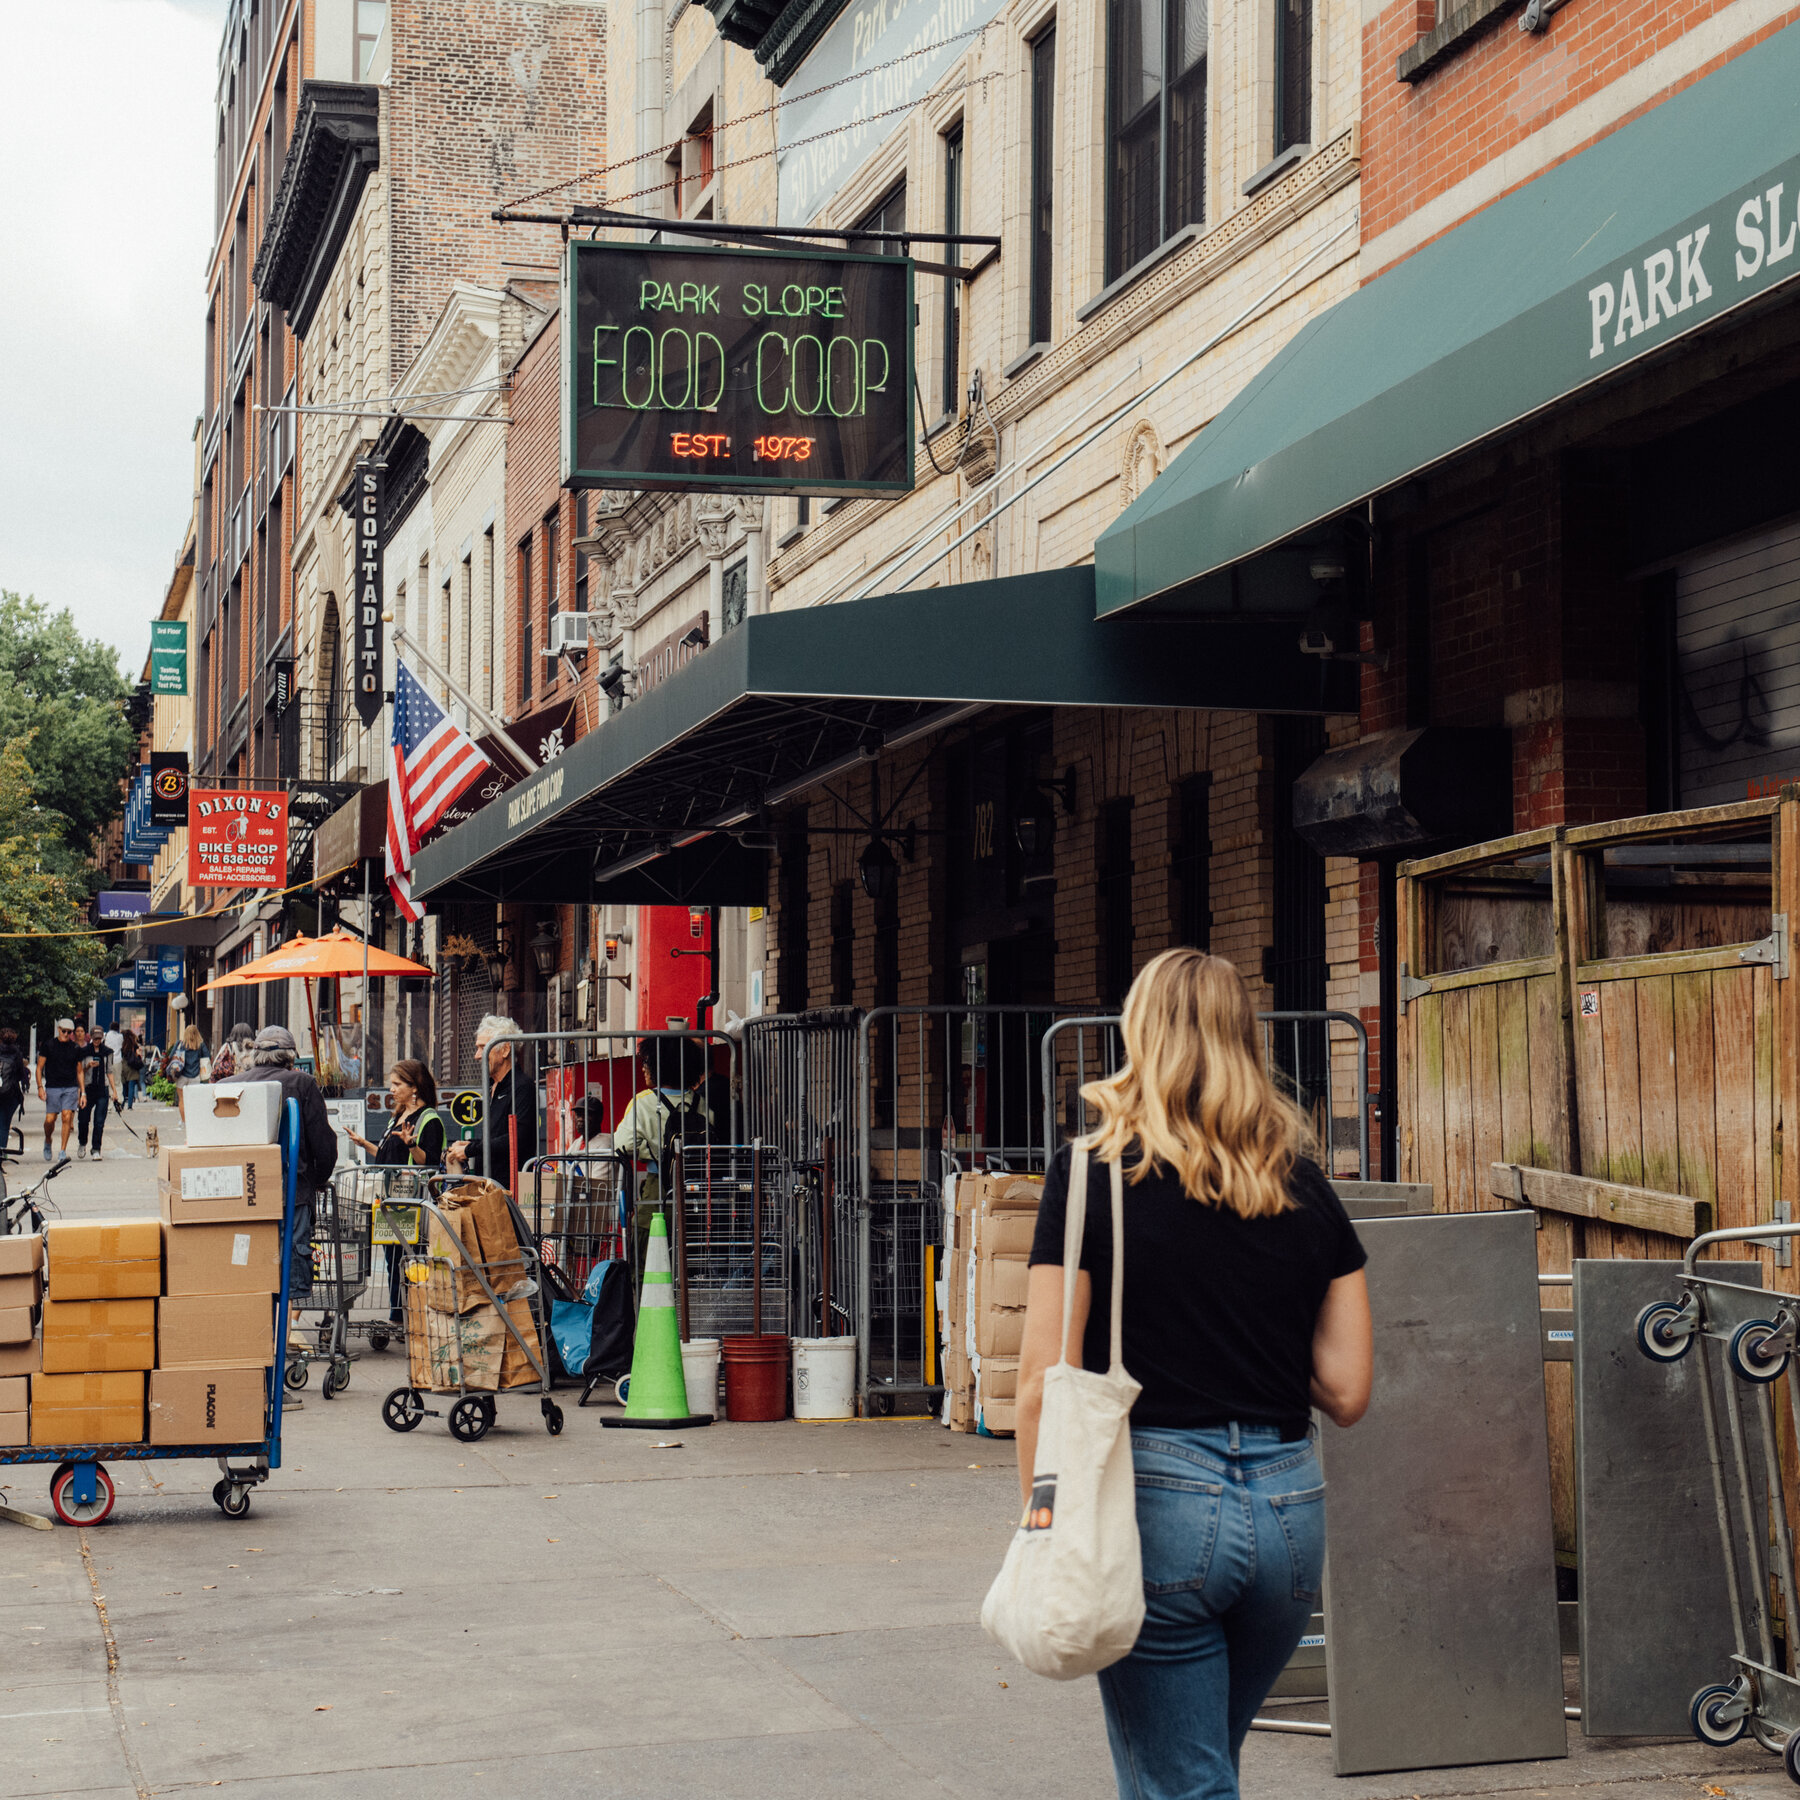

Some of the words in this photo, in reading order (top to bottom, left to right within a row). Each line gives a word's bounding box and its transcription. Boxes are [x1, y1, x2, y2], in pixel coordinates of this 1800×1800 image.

[852, 0, 887, 70] Park
[790, 152, 807, 220] 50
[809, 120, 848, 194] Years
[852, 79, 867, 145] of
[1588, 223, 1712, 360] PARK
[1735, 181, 1800, 283] SL
[640, 280, 720, 314] PARK
[742, 283, 845, 318] SLOPE
[594, 325, 725, 410] FOOD
[757, 331, 889, 417] COOP
[671, 433, 730, 458] EST.
[754, 435, 812, 460] 1973
[361, 474, 378, 693] SCOTTADITO
[197, 796, 282, 819] DIXON'S
[199, 843, 232, 853] BIKE
[237, 844, 278, 854] SHOP
[200, 854, 219, 863] 718
[223, 855, 275, 865] 636-0067
[460, 1095, 477, 1122] 3
[247, 1162, 256, 1206] PLACON
[206, 1384, 216, 1428] PLACON
